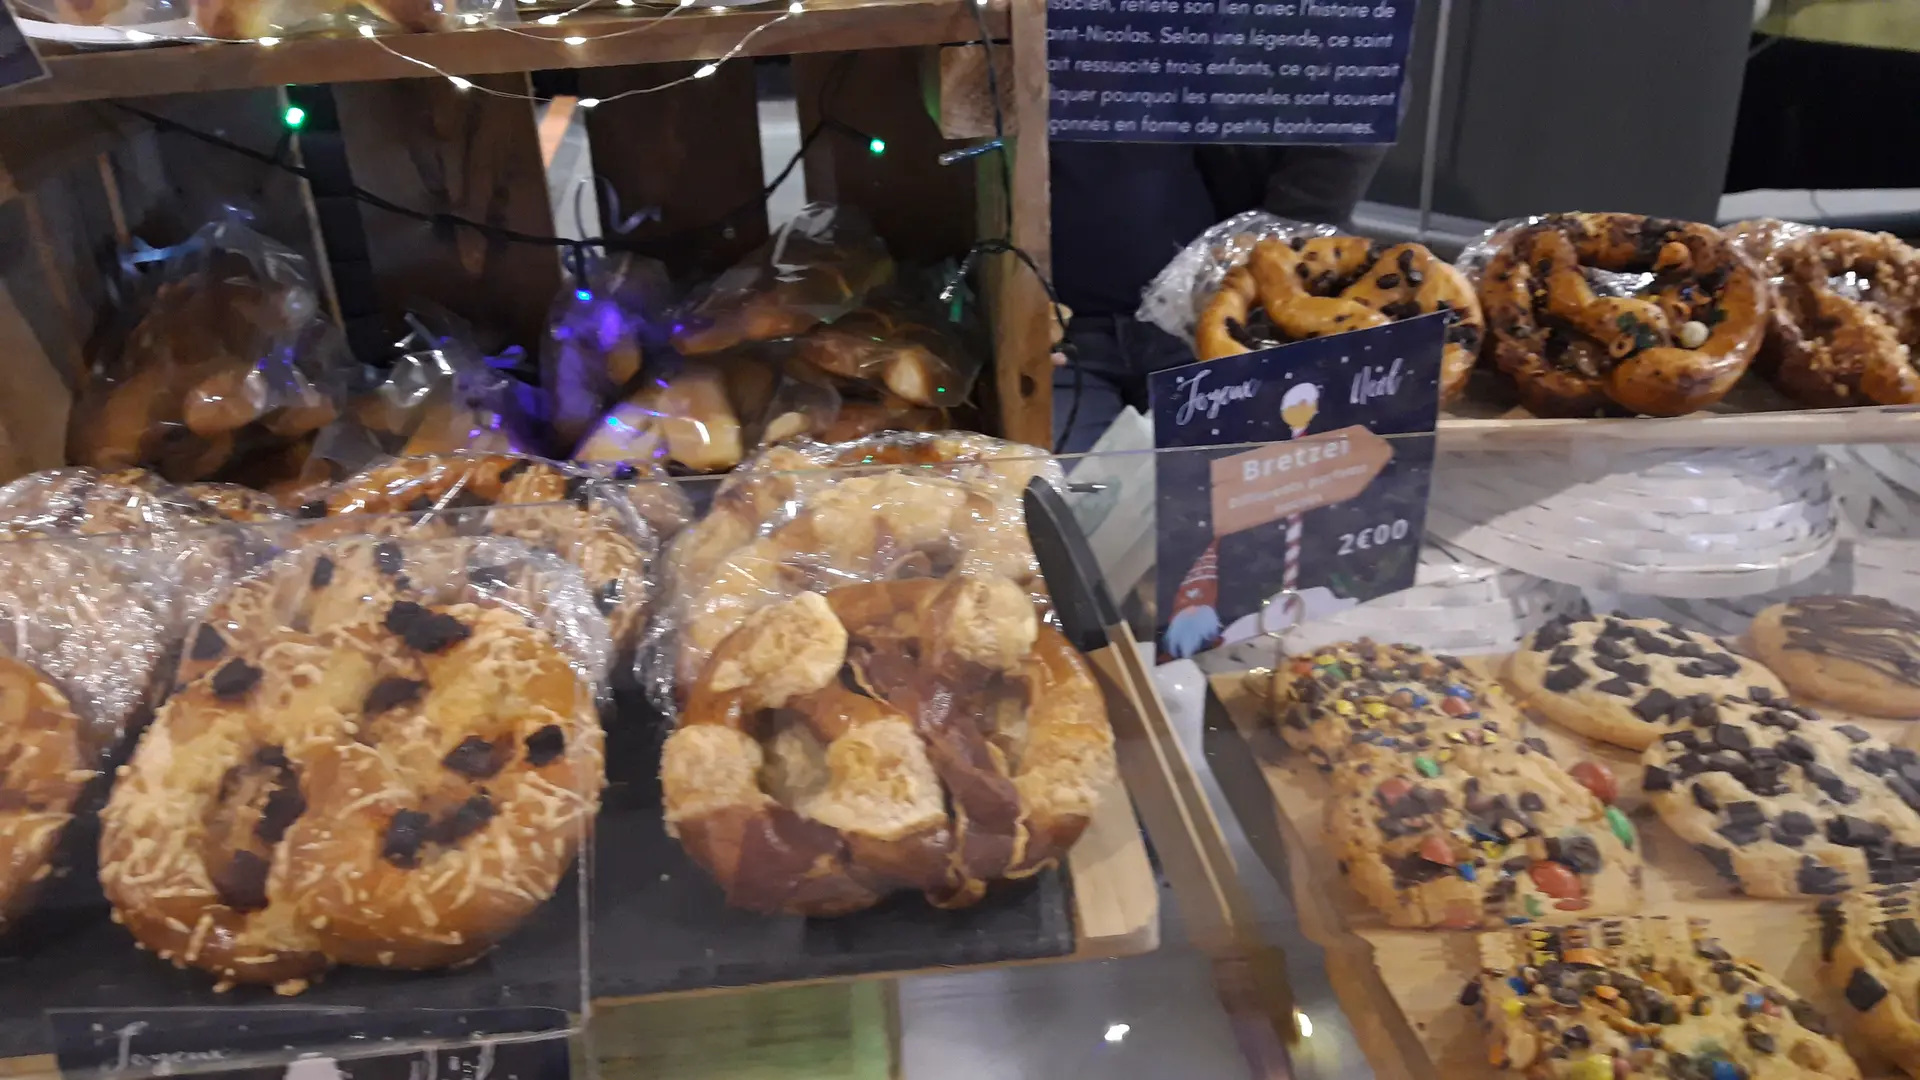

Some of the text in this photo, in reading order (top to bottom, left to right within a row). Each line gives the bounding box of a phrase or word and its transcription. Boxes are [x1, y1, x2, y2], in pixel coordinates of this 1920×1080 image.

[1183, 1, 1214, 14] son
[1217, 0, 1249, 15] lien
[1253, 3, 1296, 17] avec
[1300, 0, 1370, 17] l'histoire
[1372, 0, 1396, 18] de
[1160, 26, 1210, 44] Selon
[1213, 32, 1245, 46] une
[1248, 28, 1324, 51] légende,
[1327, 35, 1350, 48] ce
[1353, 33, 1394, 48] saint
[1074, 58, 1162, 74] ressuscité
[1165, 59, 1203, 75] trois
[1206, 57, 1275, 77] enfants,
[1279, 64, 1302, 76] ce
[1303, 62, 1332, 81] qui
[1334, 63, 1400, 82] pourrait
[1100, 87, 1178, 108] pourquoi
[1181, 86, 1207, 104] les
[1210, 87, 1291, 105] manneles
[1294, 91, 1330, 105] sont
[1333, 92, 1396, 106] souvent
[1114, 120, 1137, 132] en
[1141, 115, 1191, 133] forme
[1194, 116, 1219, 134] de
[1221, 119, 1270, 139] petits
[1273, 117, 1376, 135] bonhommes.
[1337, 519, 1409, 556] 2€00
